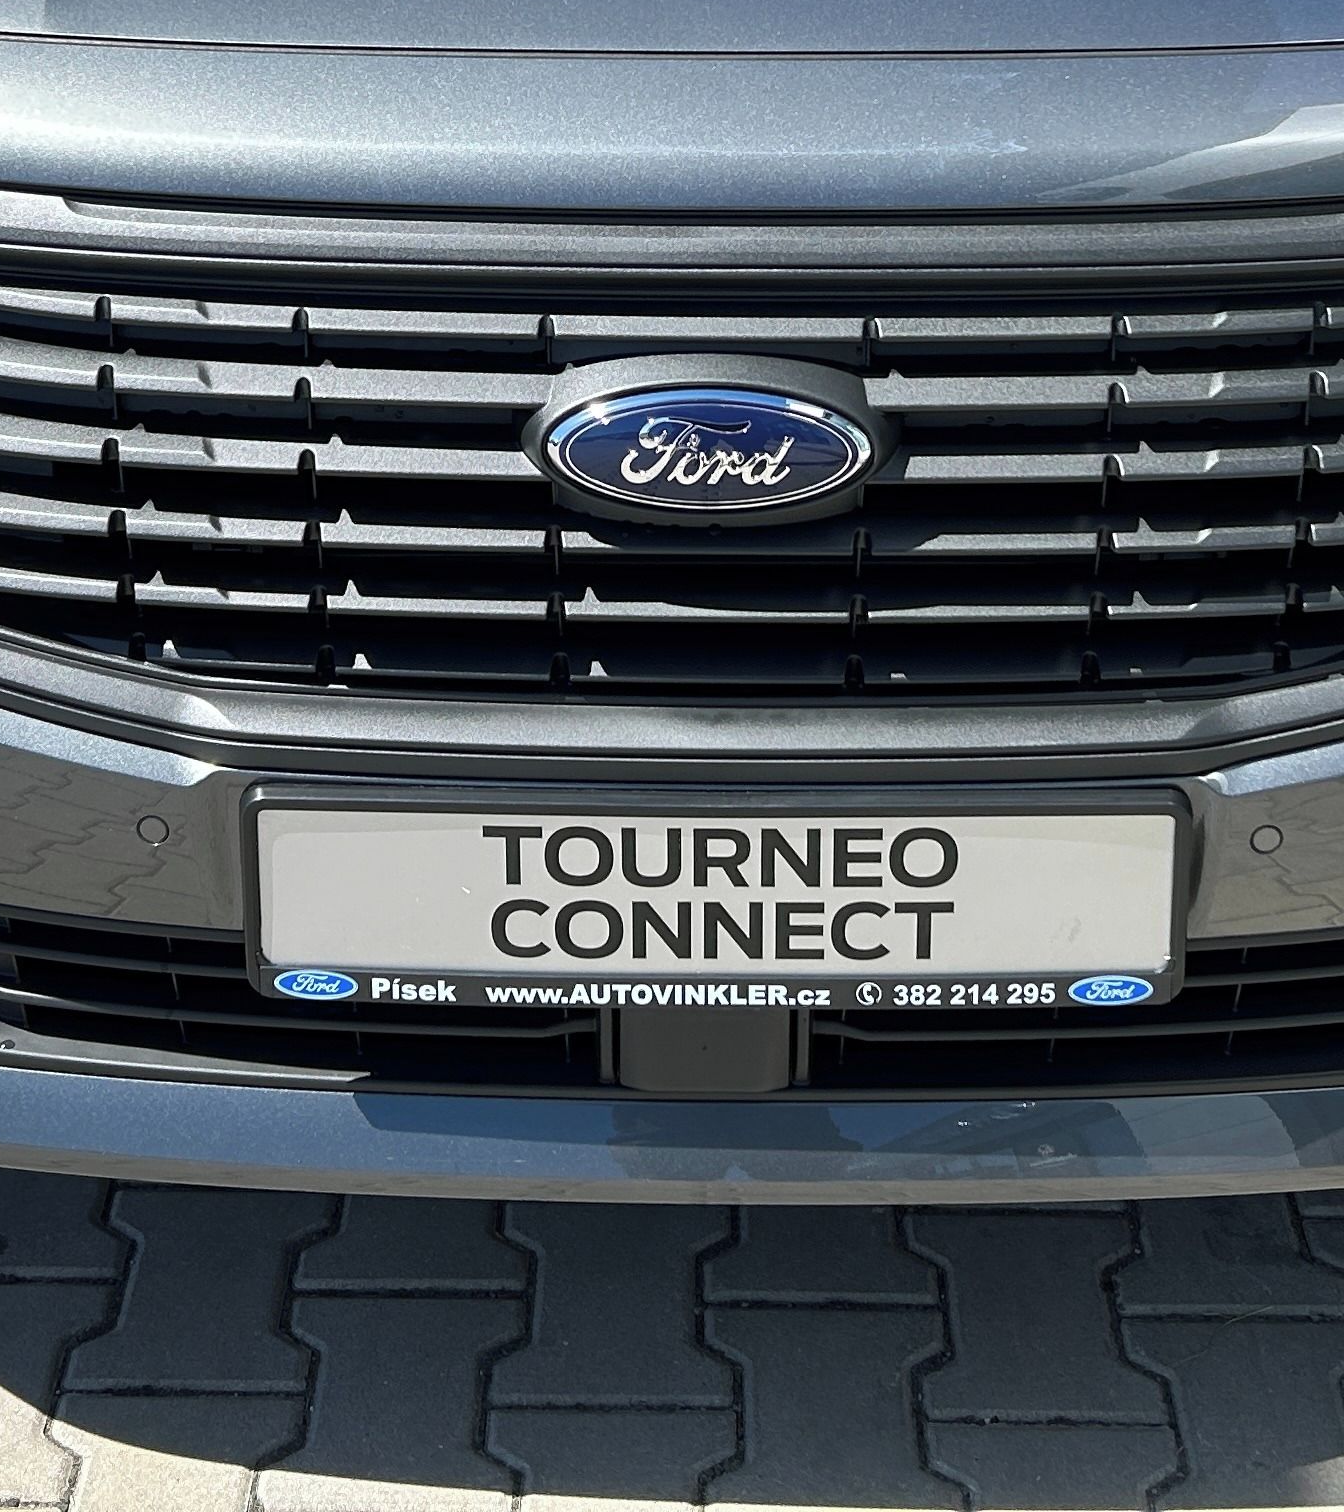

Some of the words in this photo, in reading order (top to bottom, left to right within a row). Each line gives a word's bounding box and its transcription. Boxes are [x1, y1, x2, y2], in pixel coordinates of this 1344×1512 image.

[620, 416, 795, 485] Ford
[482, 825, 959, 888] TOURNEO
[490, 898, 955, 961] CONNECT
[292, 973, 341, 994] Ford
[371, 977, 457, 1002] Písek
[484, 983, 831, 1006] www.AUTOVINKLER.cz
[892, 984, 942, 1006] 382
[949, 983, 1000, 1006] 214
[1006, 982, 1056, 1005] 295
[1085, 980, 1135, 1001] Ford
